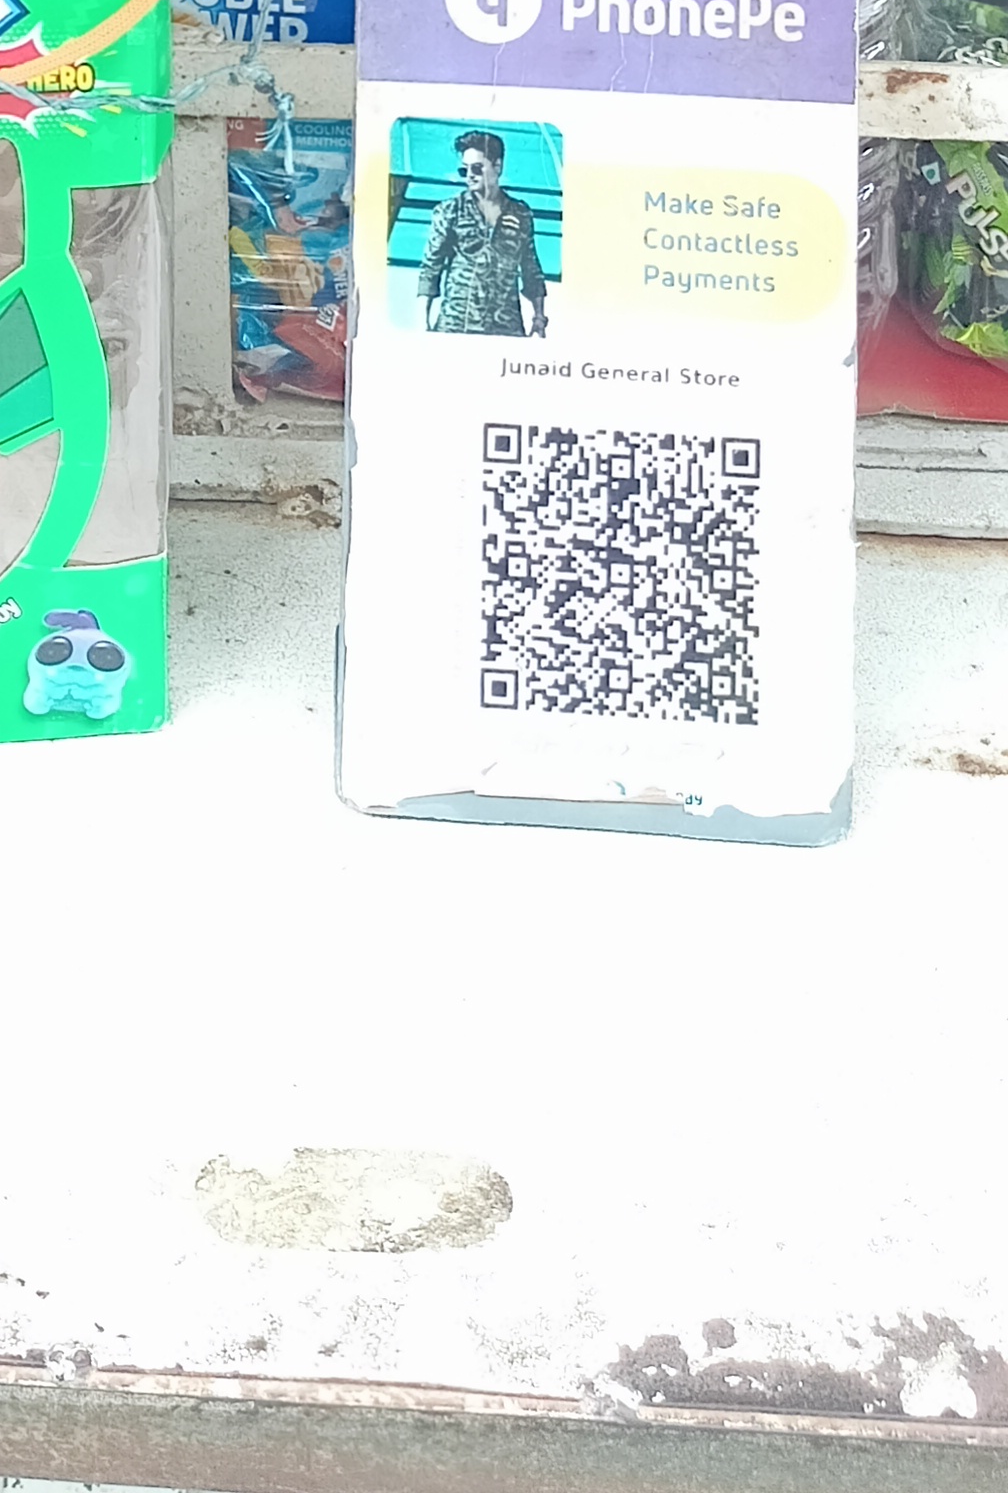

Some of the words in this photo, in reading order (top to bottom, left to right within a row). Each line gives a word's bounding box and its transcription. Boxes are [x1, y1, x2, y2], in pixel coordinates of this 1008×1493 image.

[644, 192, 713, 217] Make
[723, 195, 781, 220] Safe
[643, 228, 799, 257] Contactless
[644, 264, 776, 294] Payments
[501, 358, 572, 379] Junaid
[581, 362, 669, 384] General
[680, 368, 741, 388] Store
